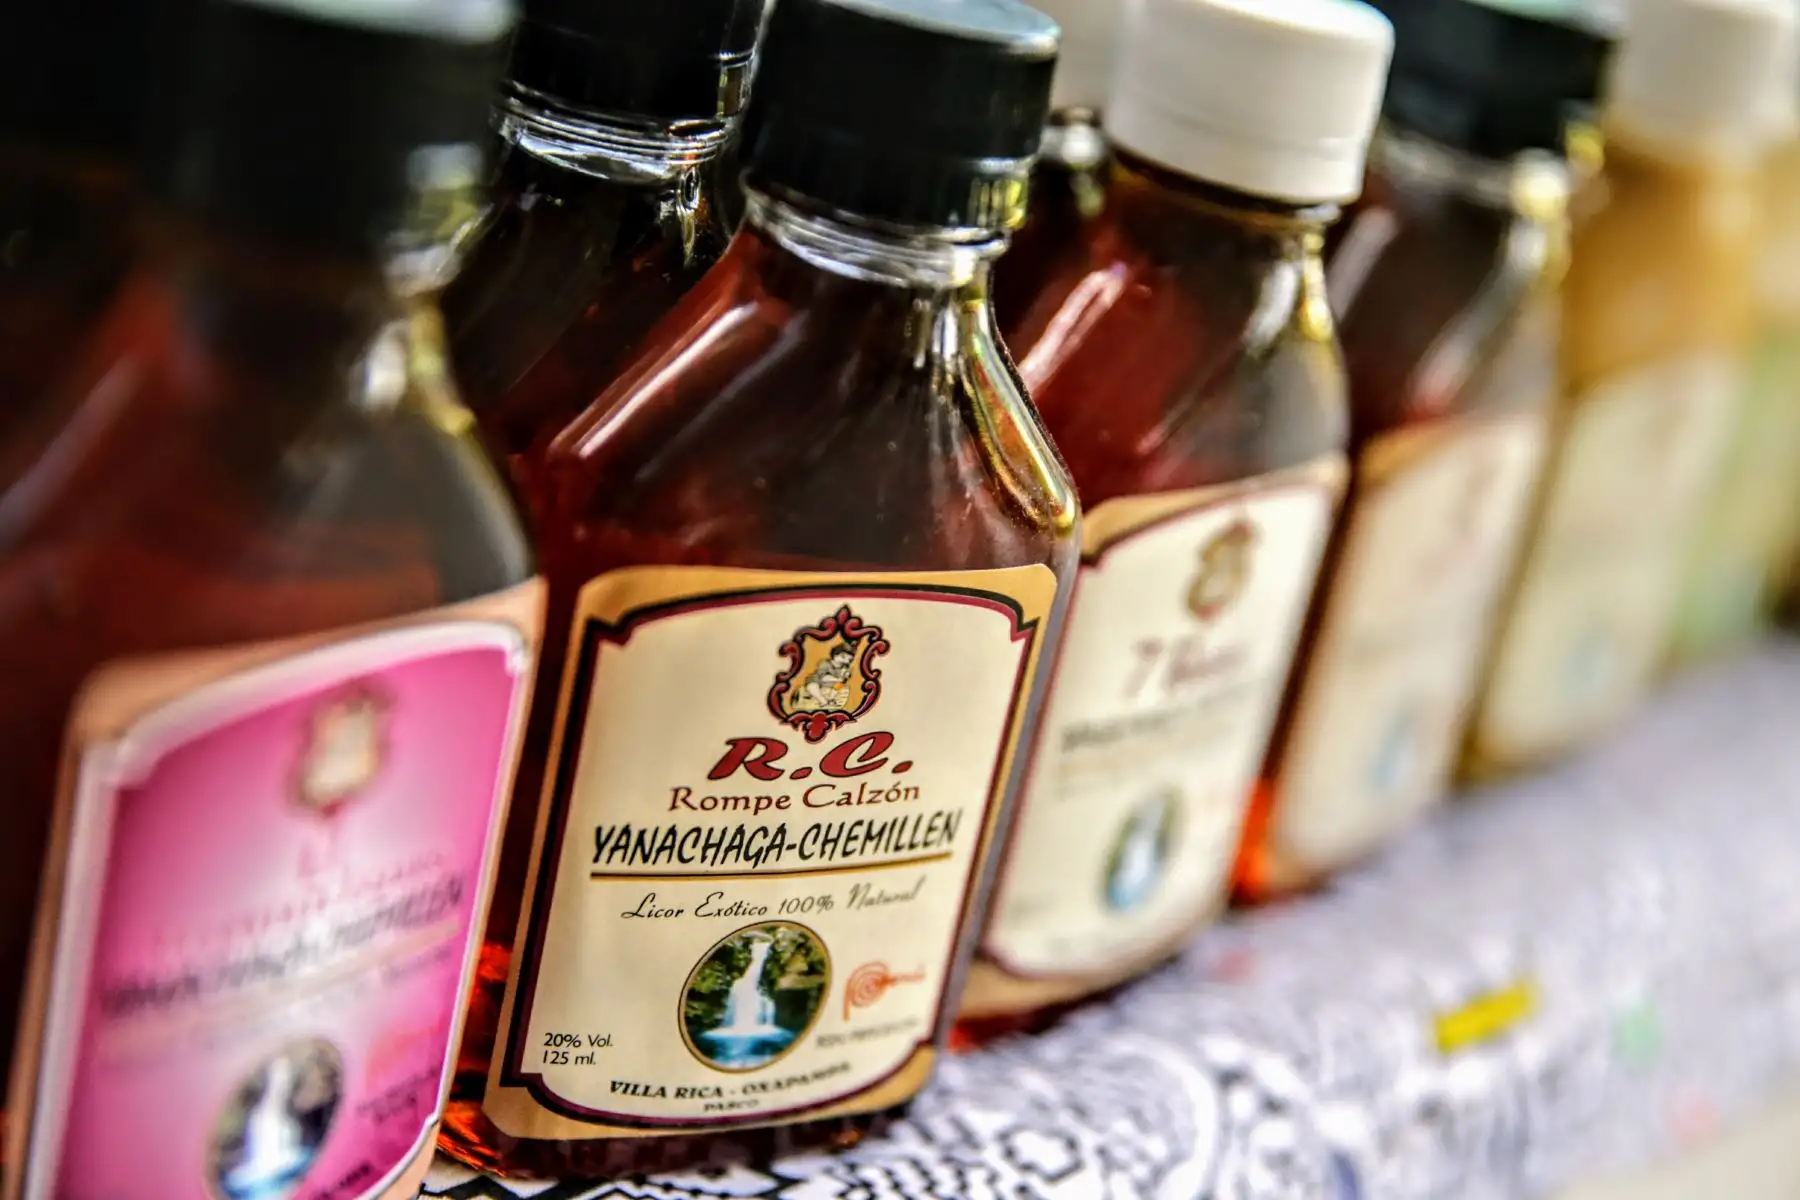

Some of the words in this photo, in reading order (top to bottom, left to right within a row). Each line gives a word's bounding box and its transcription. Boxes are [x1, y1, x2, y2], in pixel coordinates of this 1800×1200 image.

[707, 731, 914, 780] R.C.
[668, 786, 791, 816] Rompe
[802, 781, 920, 809] Calzón
[592, 807, 963, 869] YANACHAGA-CHEMILLEN
[621, 892, 685, 919] Licor
[694, 892, 768, 918] Exótico
[778, 895, 834, 915] 100%
[846, 874, 927, 911] Natural
[543, 1032, 582, 1048] 20%
[588, 1033, 614, 1048] Vol.
[543, 1049, 570, 1065] 125
[574, 1051, 596, 1065] ml.
[610, 1080, 667, 1099] VILLA
[674, 1086, 724, 1100] RICA
